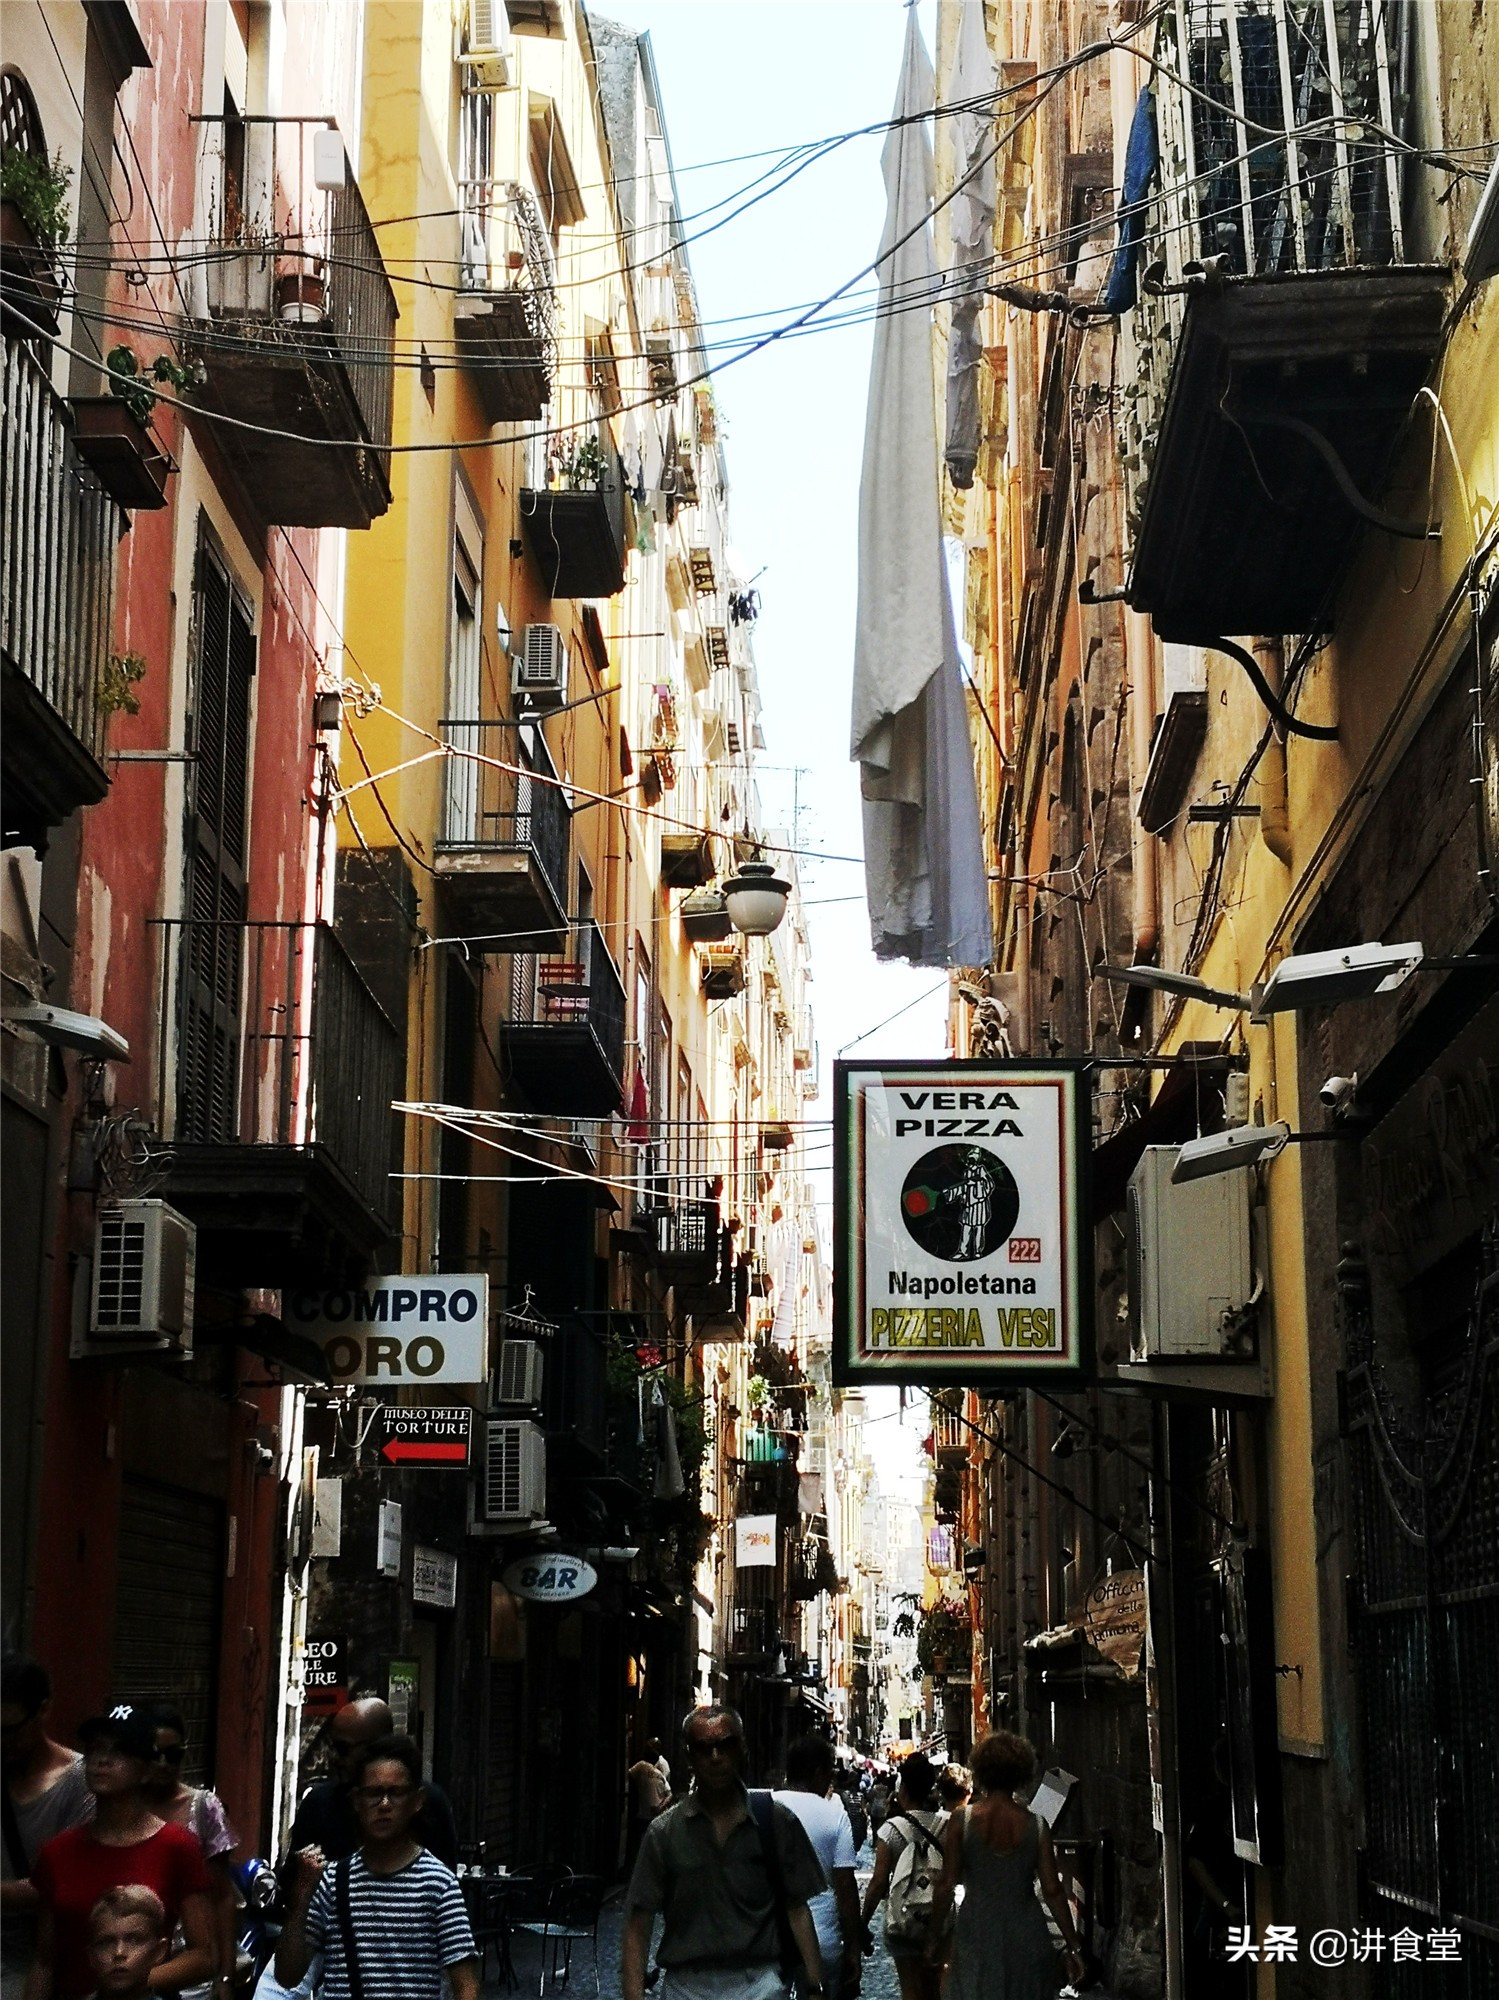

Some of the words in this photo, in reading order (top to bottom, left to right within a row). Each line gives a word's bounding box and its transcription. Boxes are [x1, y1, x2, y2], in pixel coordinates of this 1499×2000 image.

[900, 1092, 1020, 1110] VERA
[896, 1119, 1024, 1137] PIZZA
[1010, 1240, 1040, 1261] 222
[889, 1271, 1036, 1300] Napoletana
[292, 1288, 478, 1323] COMPRO
[872, 1307, 985, 1347] PIZZERIA
[997, 1307, 1056, 1348] VESI
[324, 1335, 445, 1377] ORO
[384, 1409, 427, 1420] MUSEO
[431, 1410, 469, 1420] DELLE
[383, 1420, 469, 1435] TORTURE
[521, 1567, 578, 1590] BAR
